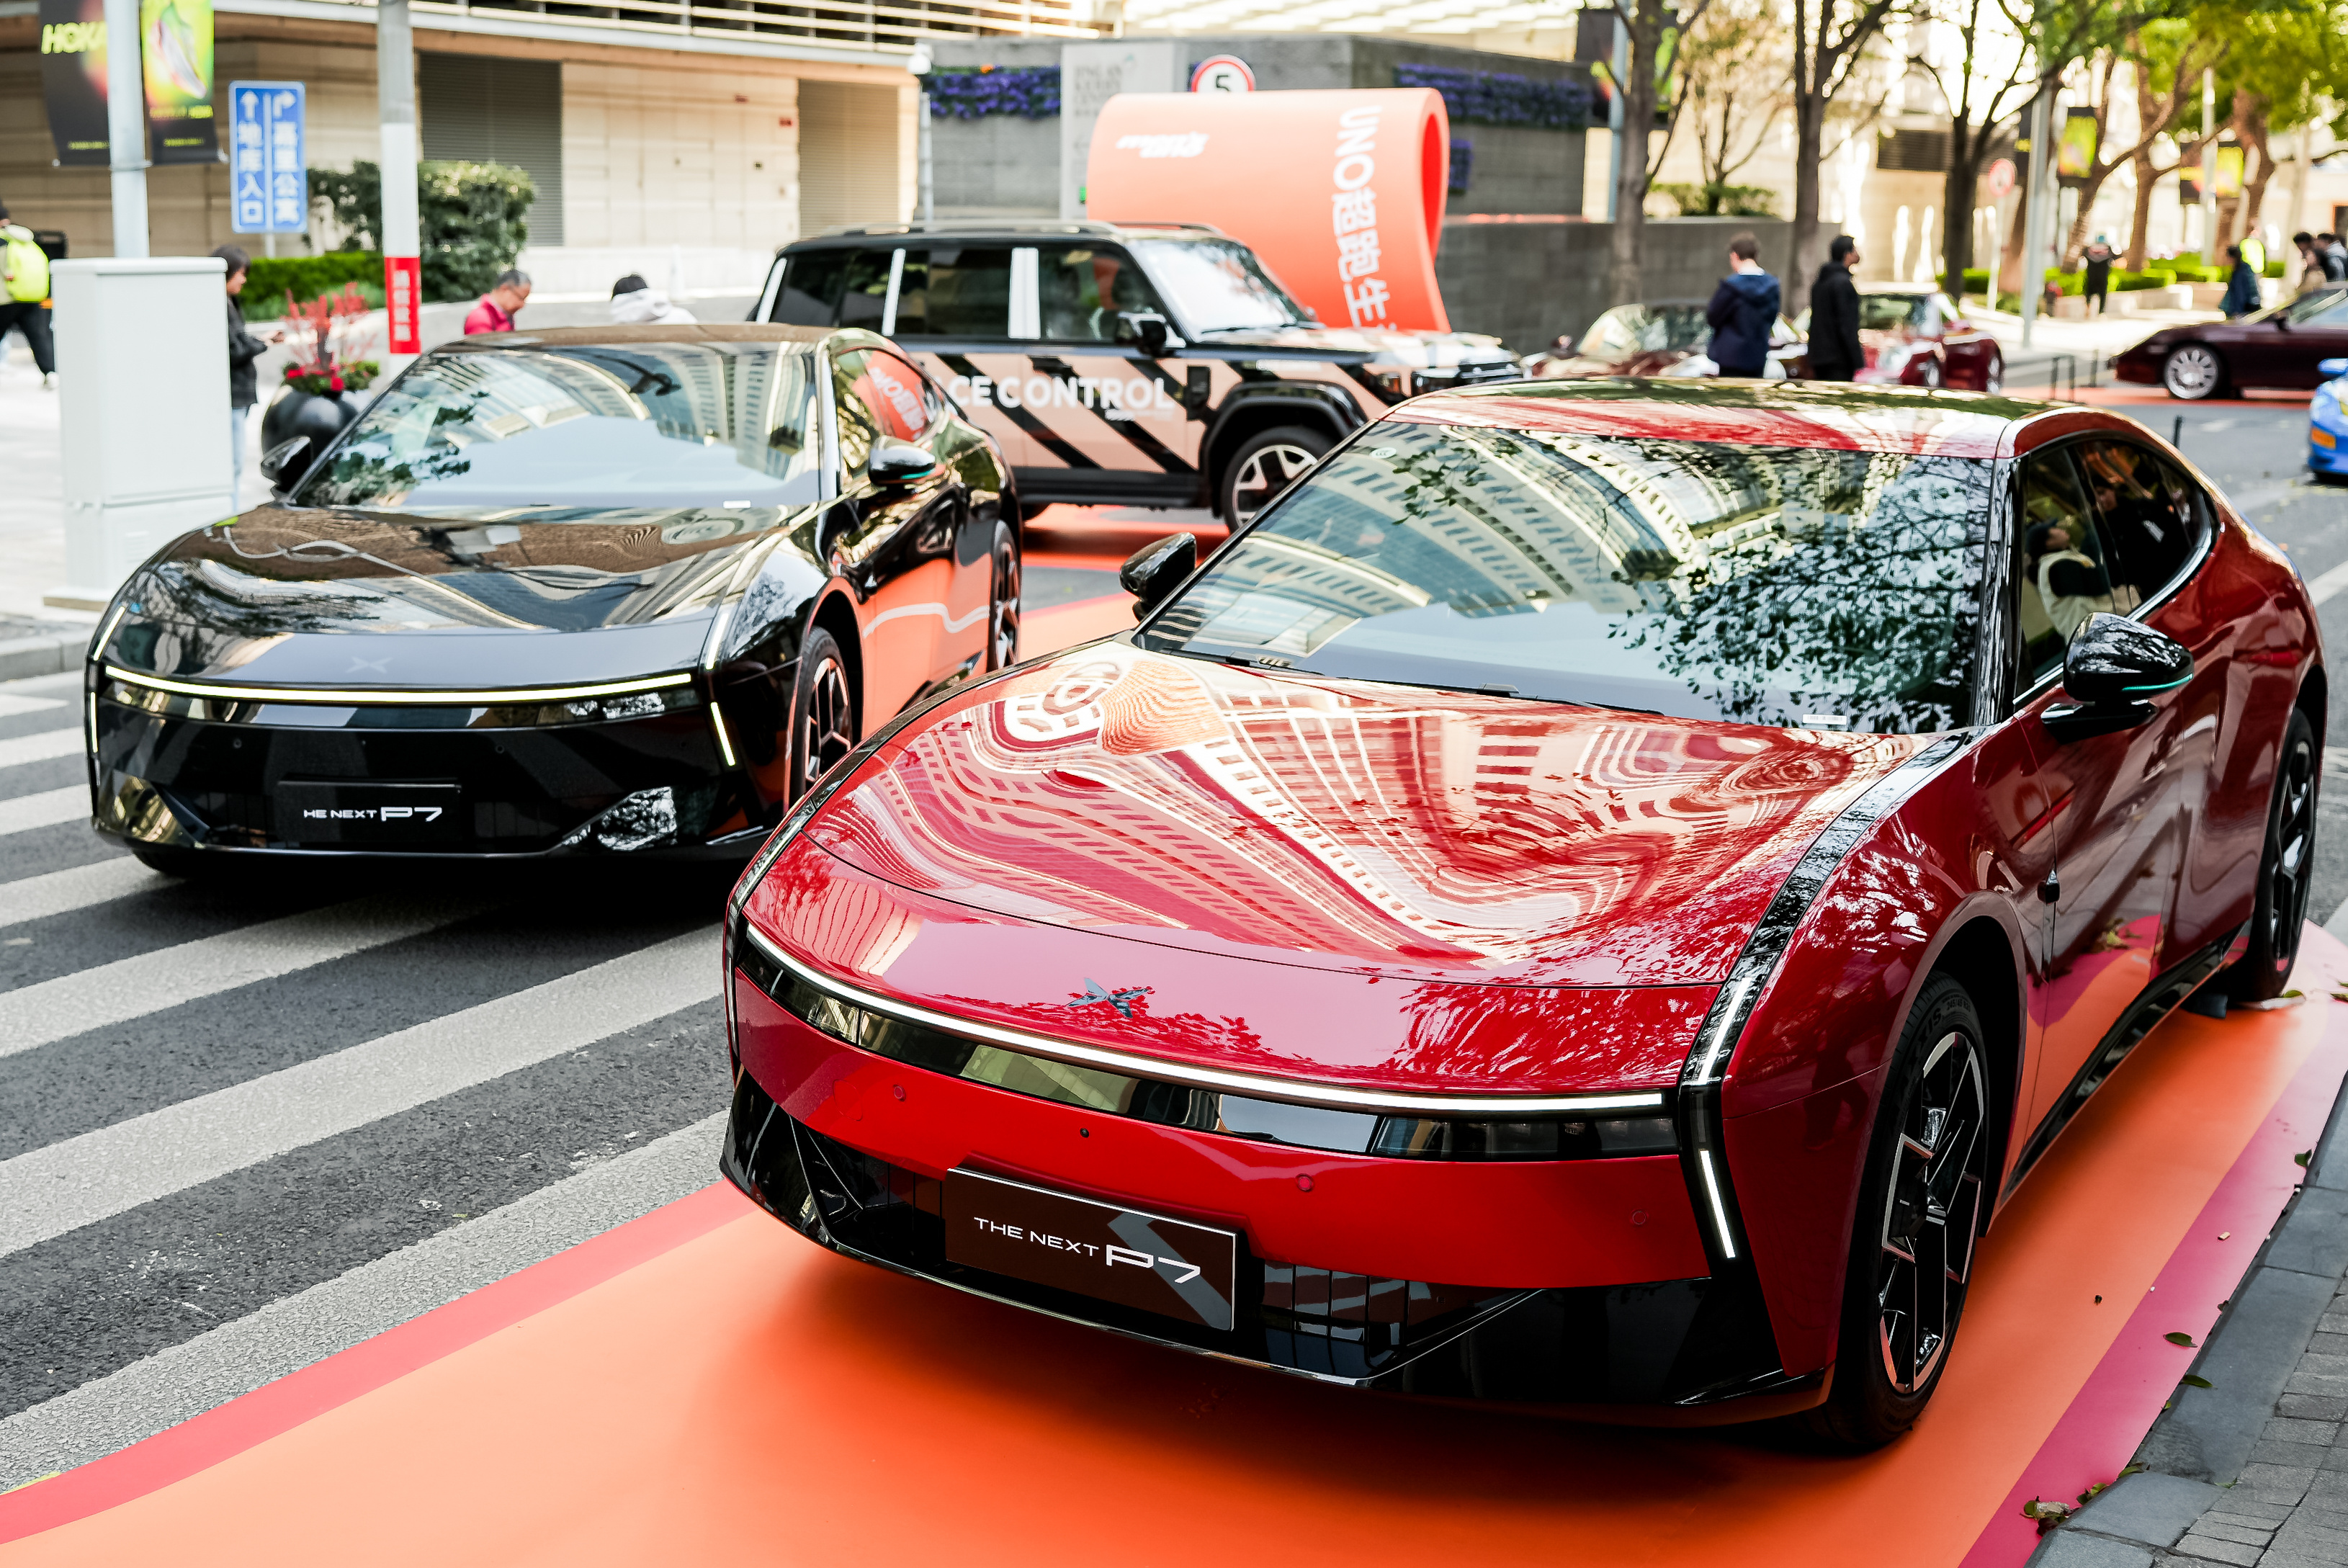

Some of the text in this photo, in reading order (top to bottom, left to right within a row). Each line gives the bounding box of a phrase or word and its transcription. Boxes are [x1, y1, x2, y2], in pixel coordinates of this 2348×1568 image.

[1216, 74, 1230, 92] 5
[935, 375, 993, 408] CE
[997, 375, 1175, 409] CONTROL
[331, 809, 377, 820] NEXT
[380, 806, 443, 822] P7
[974, 1217, 1201, 1284] THE NEXT P7
